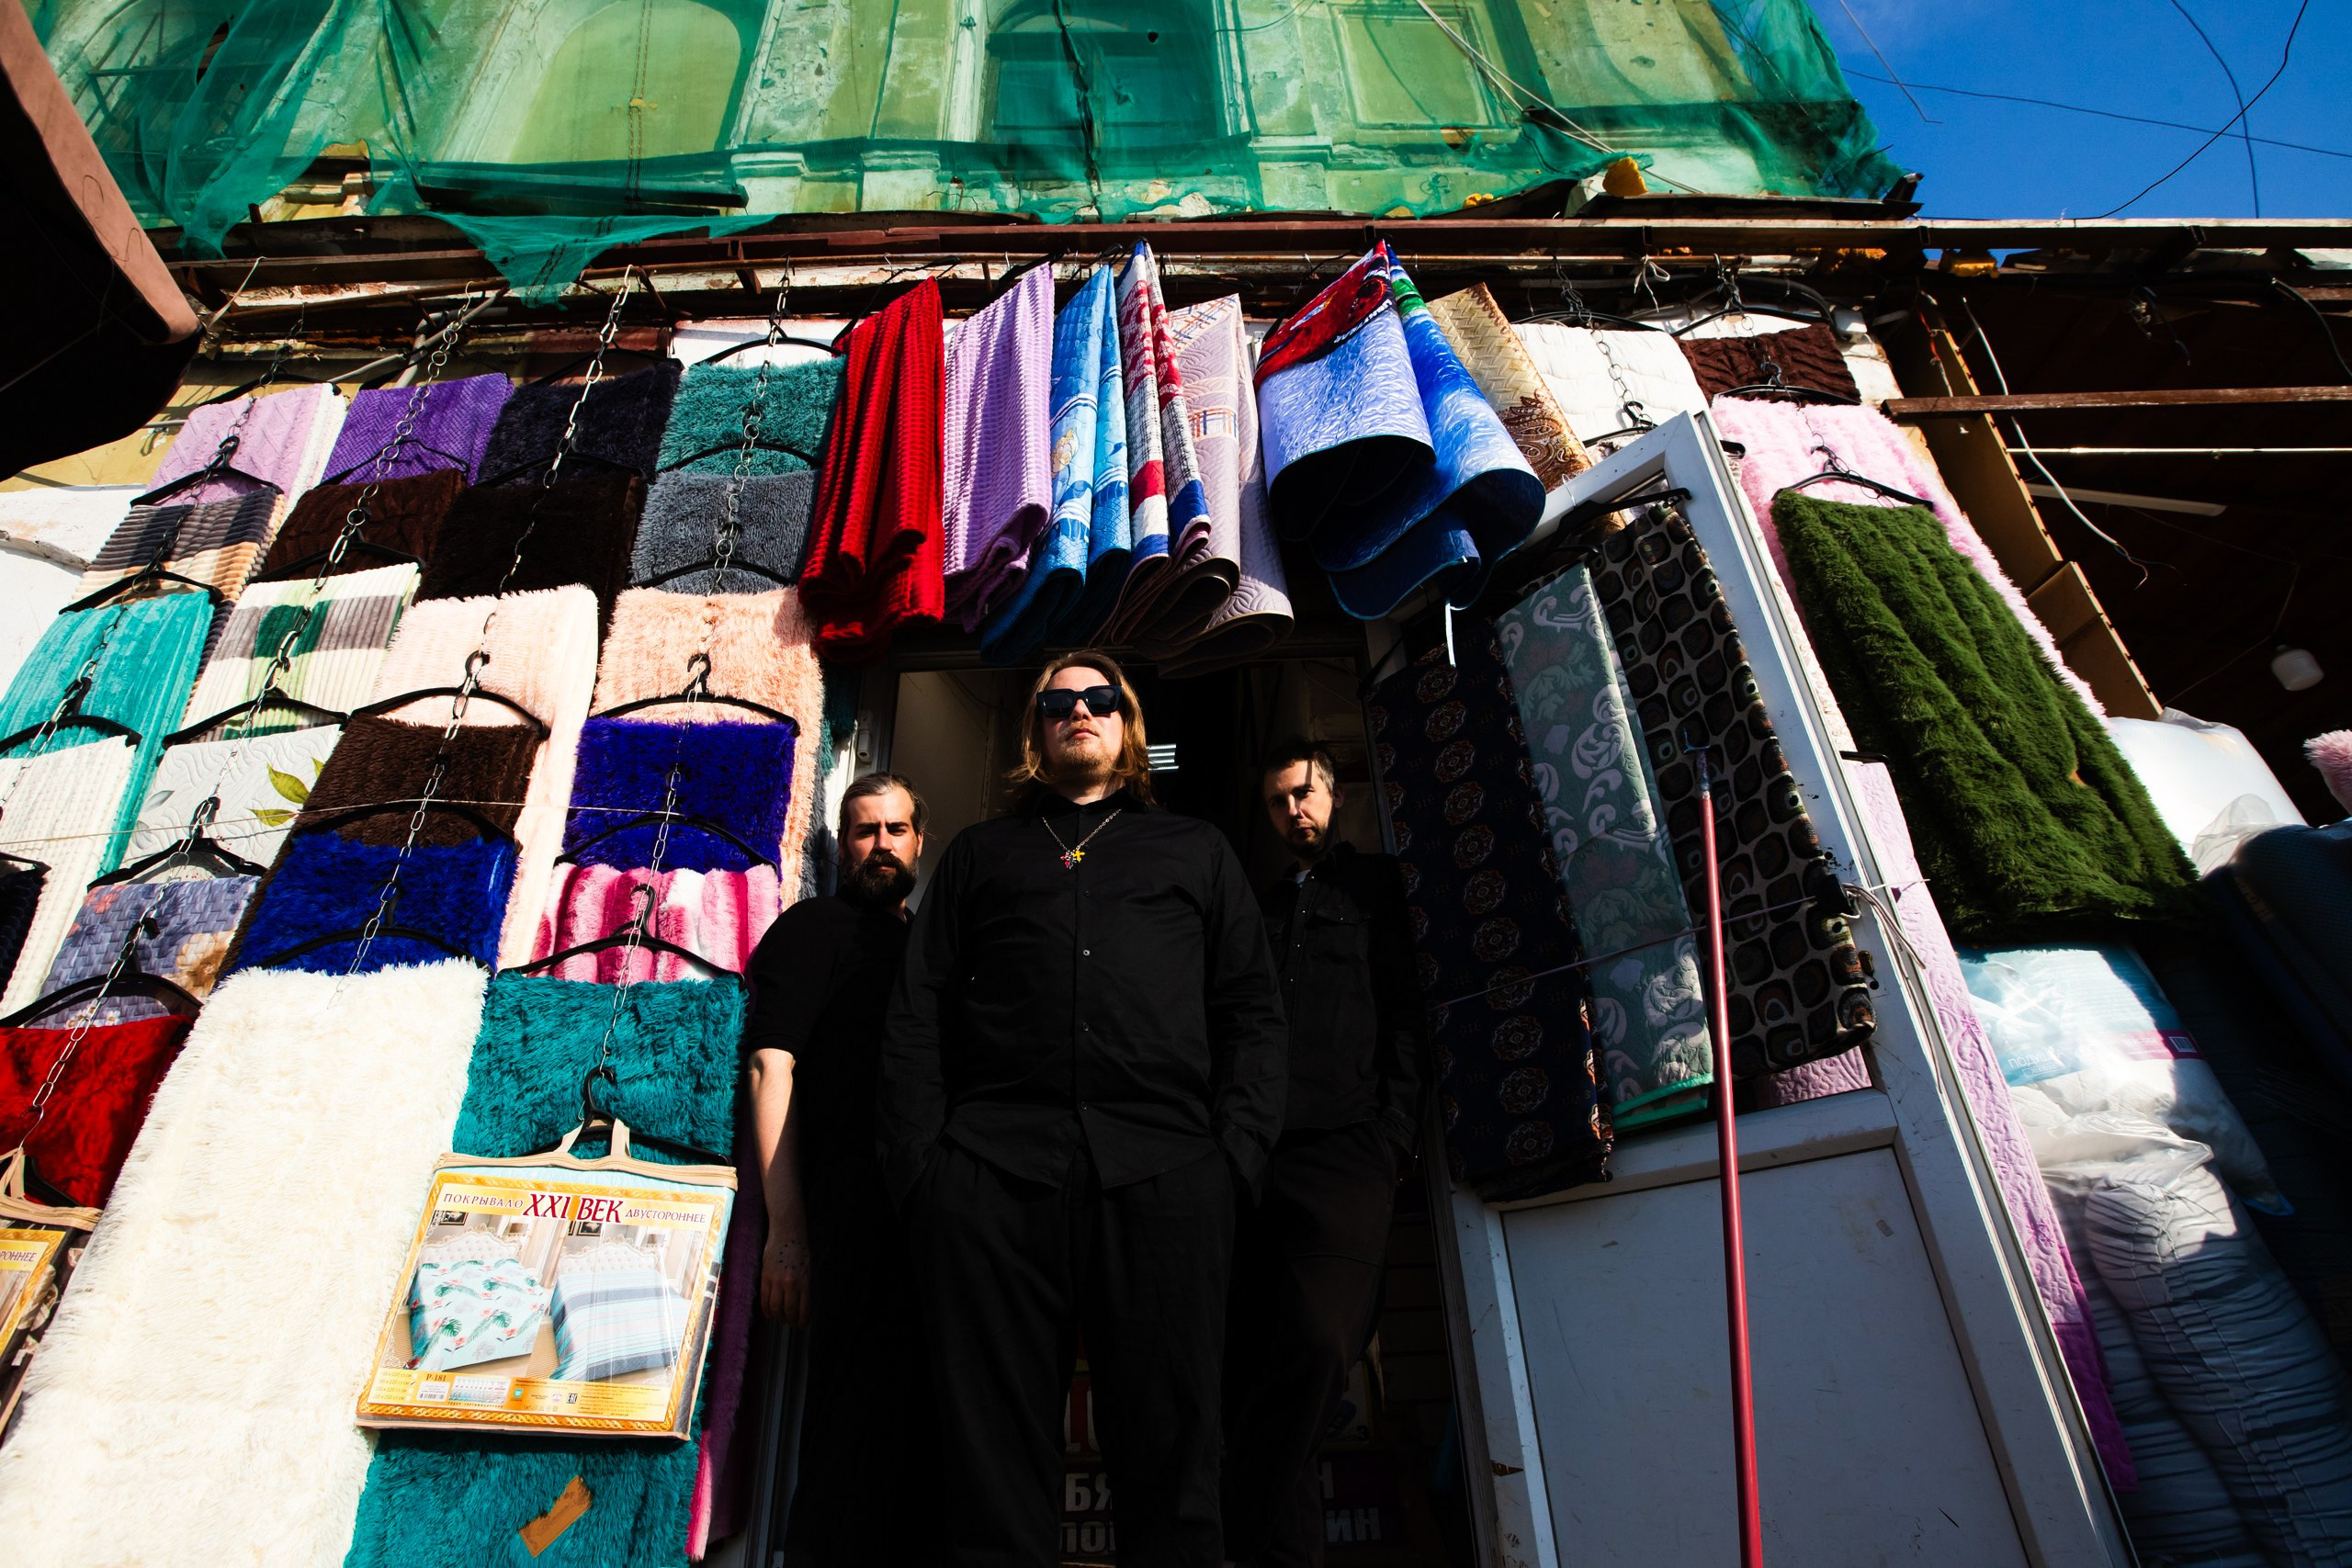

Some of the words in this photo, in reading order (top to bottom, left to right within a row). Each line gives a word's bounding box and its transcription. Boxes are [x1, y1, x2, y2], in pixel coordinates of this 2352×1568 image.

[443, 1193, 524, 1209] ПОКРЫВАЛО
[523, 1193, 571, 1220] XXI
[576, 1196, 625, 1224] ВЕК
[625, 1208, 707, 1224] ДВУСТОРОННЕЕ
